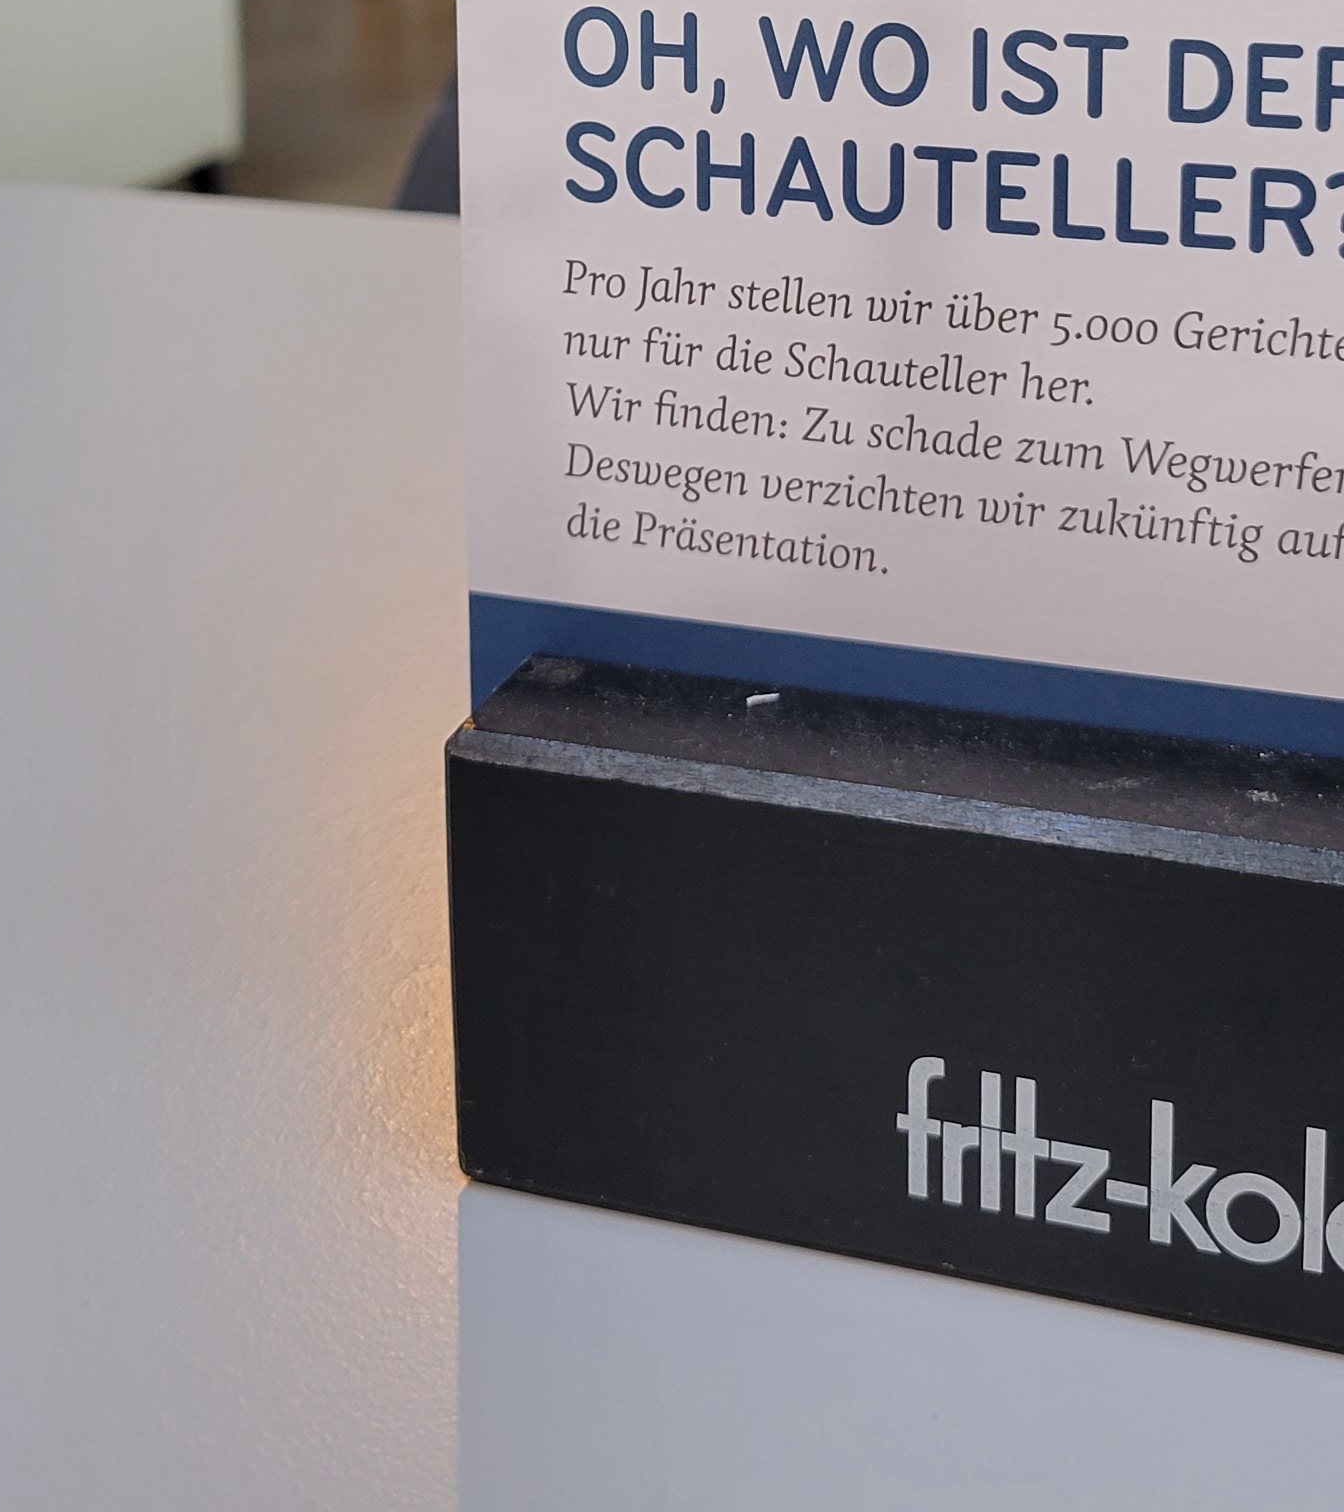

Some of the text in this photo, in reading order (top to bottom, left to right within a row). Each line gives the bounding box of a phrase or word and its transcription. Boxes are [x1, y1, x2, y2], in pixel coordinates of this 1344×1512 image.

[563, 5, 727, 114] OH,
[758, 16, 930, 104] WO
[972, 27, 1129, 119] IST
[563, 259, 626, 299] Pro
[636, 264, 715, 312] Jahr
[727, 274, 853, 320] stellen
[866, 289, 933, 327] wir
[946, 294, 1039, 337] über
[1052, 308, 1159, 348] 5.000
[564, 325, 1094, 406] nur für die Schauteller her.
[566, 383, 642, 425] Wir
[653, 389, 789, 440] finden:
[801, 406, 854, 445] Zu
[867, 414, 1001, 461] schade
[1015, 437, 1104, 471] zum
[565, 444, 747, 500] Deswegen
[761, 467, 964, 522] verzichten
[977, 492, 1046, 528] wir
[1058, 498, 1262, 561] zukünftig
[566, 502, 888, 575] die Präsentation.
